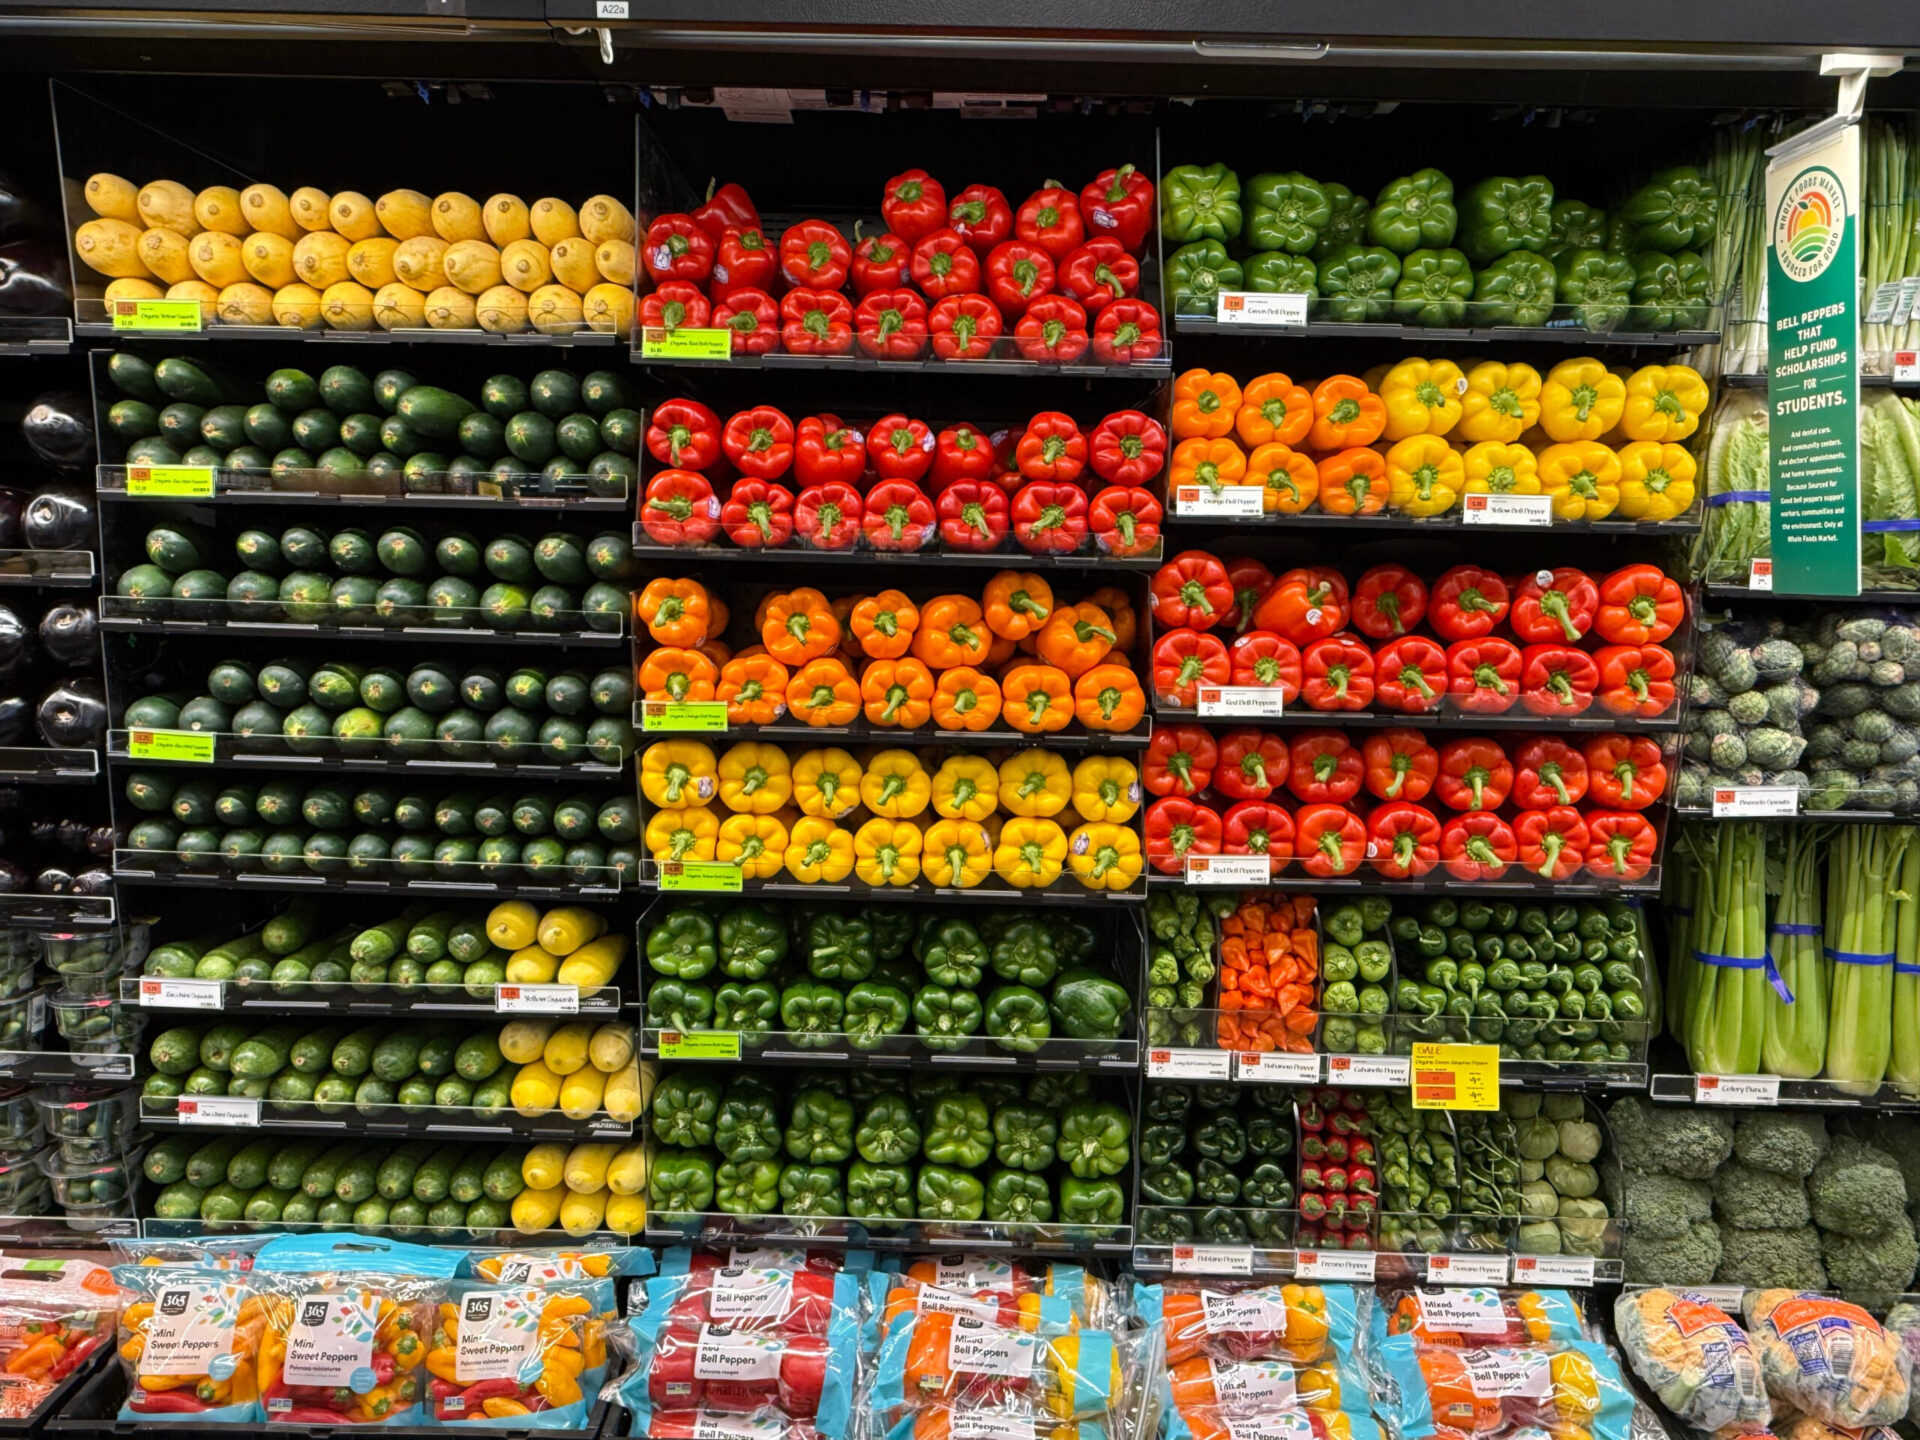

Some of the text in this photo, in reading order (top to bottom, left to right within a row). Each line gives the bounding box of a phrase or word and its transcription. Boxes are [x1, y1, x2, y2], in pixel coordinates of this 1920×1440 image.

[602, 5, 625, 14] A22a
[1779, 177, 1841, 230] WHOLE FOODS MARKET
[1780, 233, 1838, 277] SOURCED FOR GOOD
[1777, 302, 1845, 331] BELL PEPPERS
[1797, 325, 1822, 341] THAT
[1784, 338, 1837, 360] HELP FUND
[1776, 352, 1847, 378] SCHOLARSHIPS
[1803, 378, 1817, 390] FOR
[1776, 390, 1847, 415] STUDENTS.
[1802, 428, 1818, 436] dental
[1792, 442, 1820, 451] community
[1808, 481, 1828, 489] Sourced
[1803, 496, 1823, 504] peppers
[1824, 494, 1844, 502] support
[1801, 508, 1833, 516] communities
[1417, 1046, 1441, 1055] SALE
[164, 1294, 186, 1307] 365
[716, 1294, 731, 1302] Bell
[923, 1292, 950, 1301] Mixed
[304, 1305, 326, 1318] 365
[468, 1301, 489, 1313] 365
[922, 1302, 974, 1315] Bell Peppers
[1445, 1310, 1480, 1318] Peppers
[153, 1329, 176, 1338] Mini
[293, 1339, 316, 1349] Mini
[460, 1346, 488, 1355] Sweet
[954, 1345, 970, 1354] Bell
[290, 1351, 358, 1363] Sweet Peppers
[701, 1354, 756, 1366] Bell Peppers
[1474, 1372, 1491, 1380] Bell
[954, 1422, 970, 1430] Bell
[699, 1430, 716, 1438] Bell
